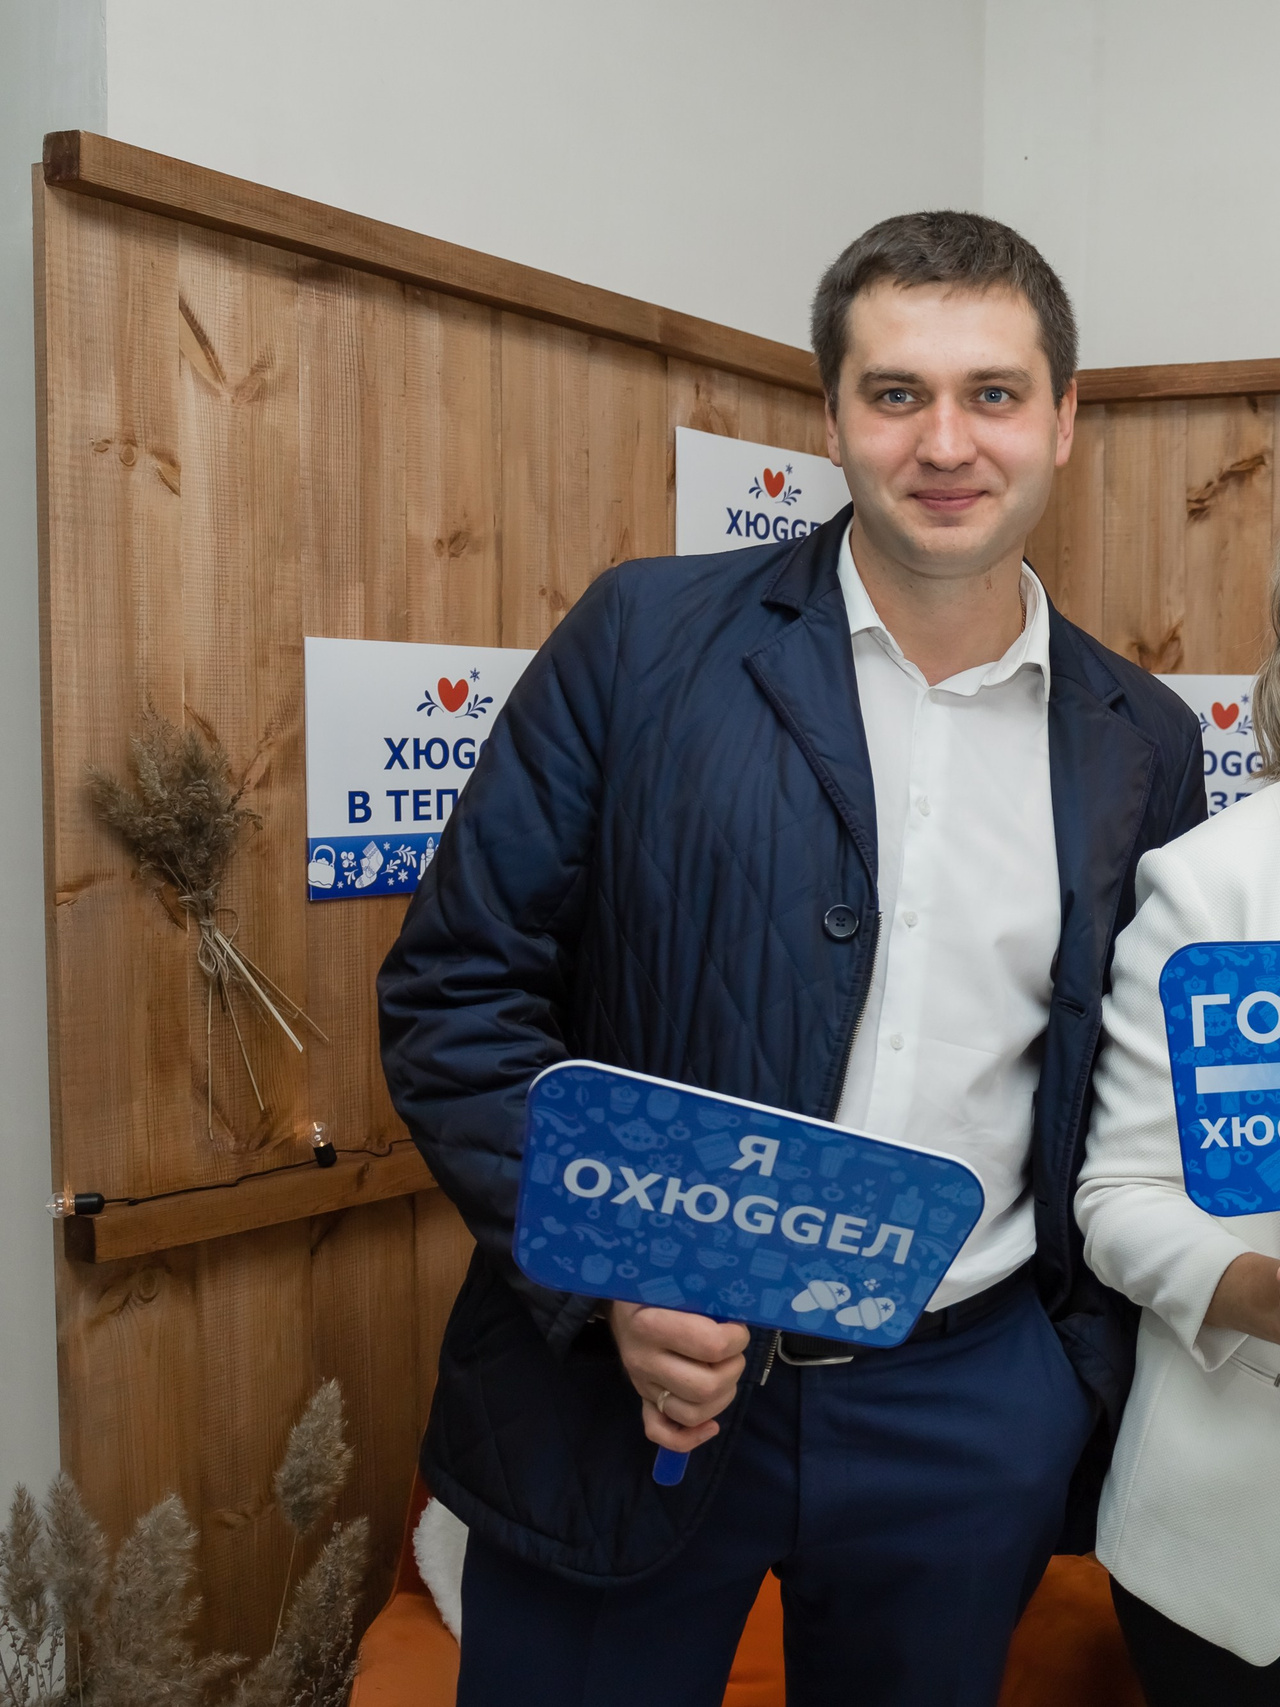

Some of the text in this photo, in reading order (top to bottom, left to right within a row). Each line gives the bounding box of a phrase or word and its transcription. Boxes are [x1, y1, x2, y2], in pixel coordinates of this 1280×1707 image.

[383, 737, 488, 770] ХЮG
[347, 790, 372, 824] В
[729, 1134, 781, 1177] Я
